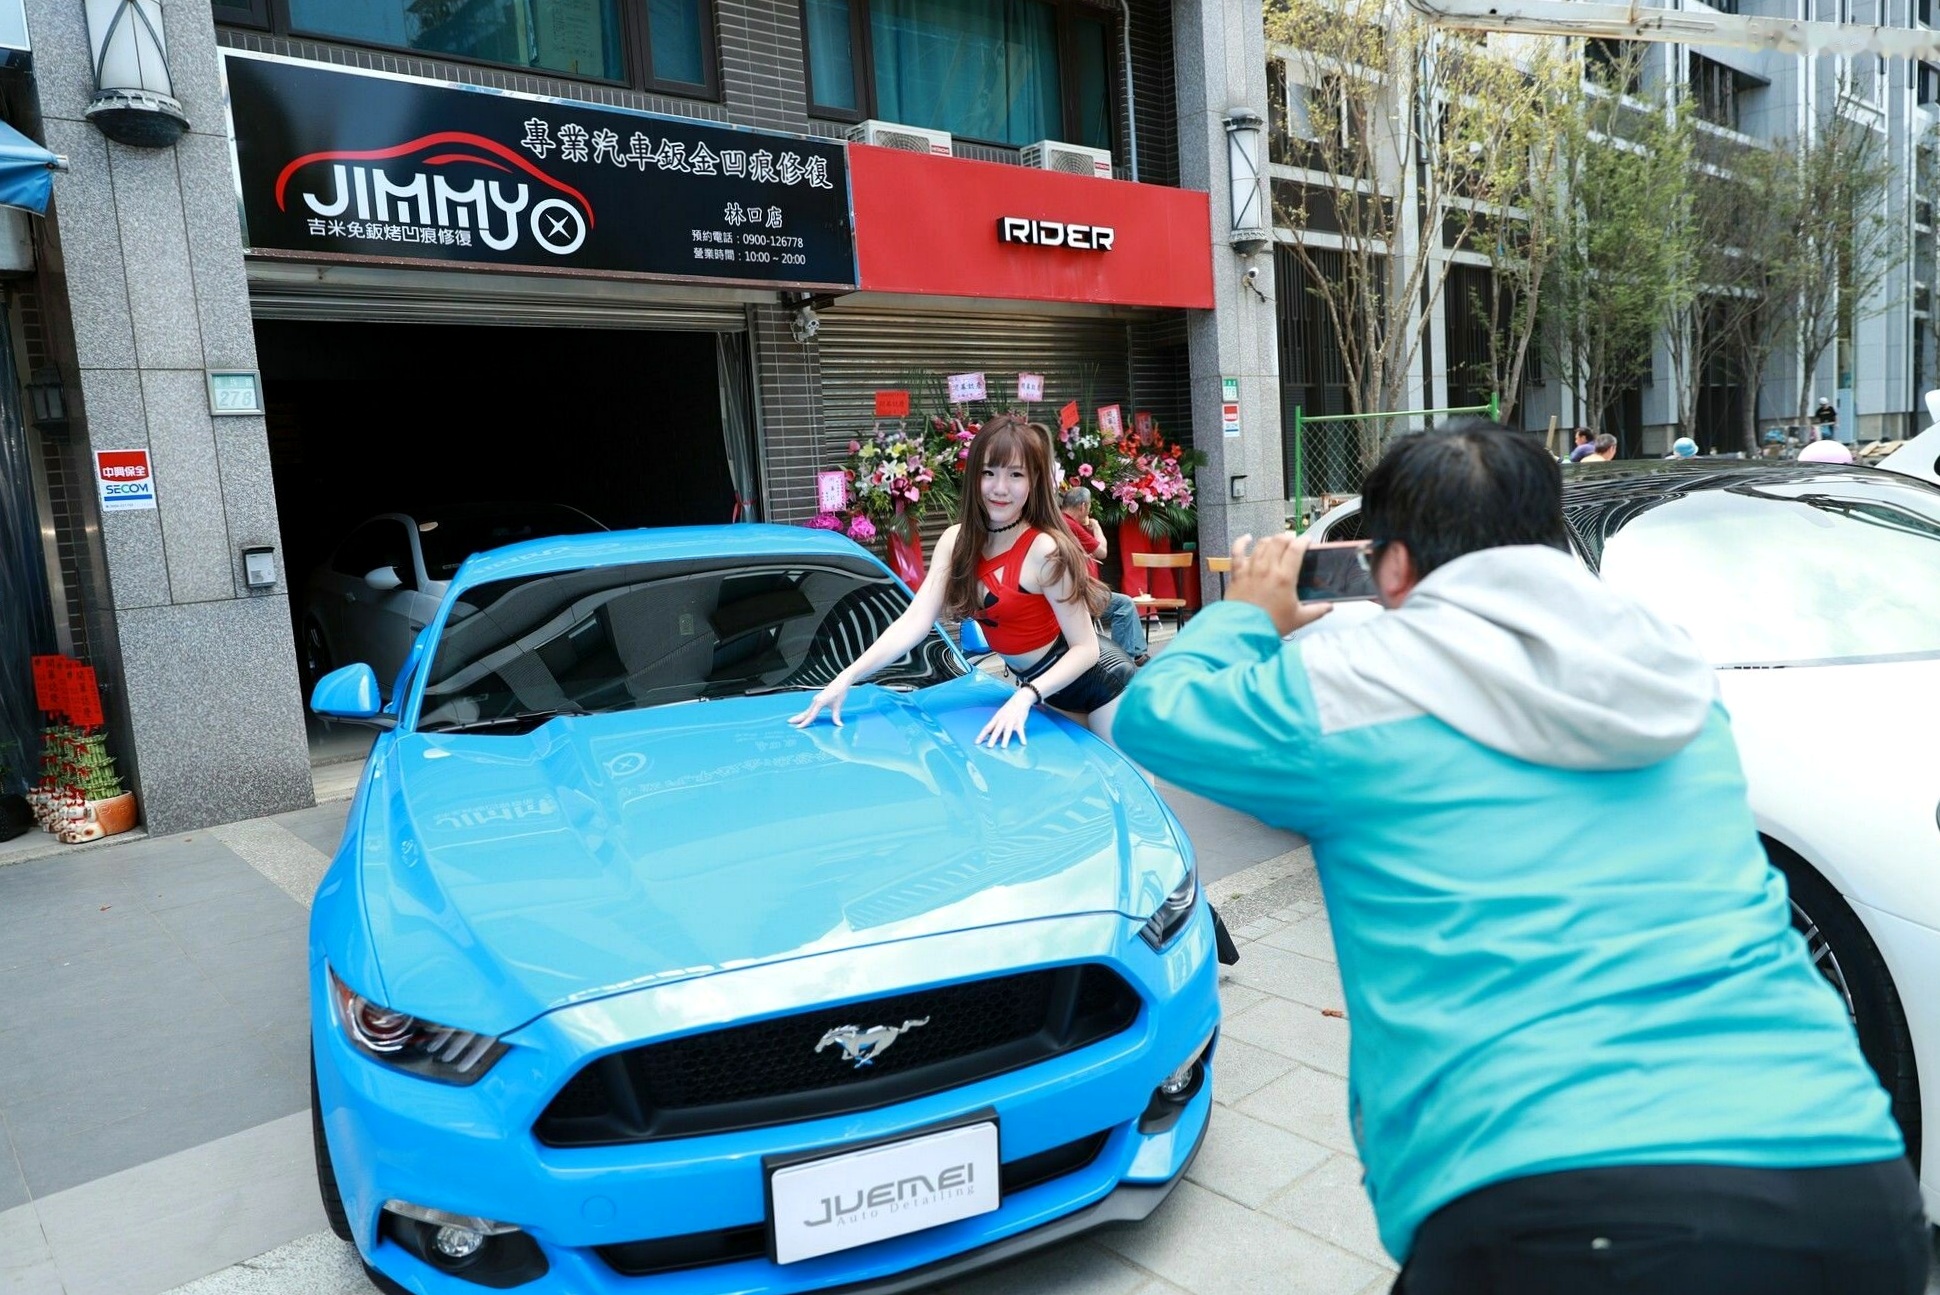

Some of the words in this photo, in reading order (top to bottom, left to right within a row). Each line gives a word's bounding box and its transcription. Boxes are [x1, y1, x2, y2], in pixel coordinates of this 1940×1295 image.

[521, 117, 833, 189] 專業汽車鈑金凹痕修復
[306, 217, 473, 247] 吉米免鈑烤凹痕修復
[724, 202, 783, 228] 林口店
[1001, 216, 1115, 251] RIDER
[105, 483, 149, 495] SECOM
[803, 1162, 974, 1228] JUEMEI
[837, 1210, 879, 1228] Auto
[890, 1185, 976, 1214] Detailing
